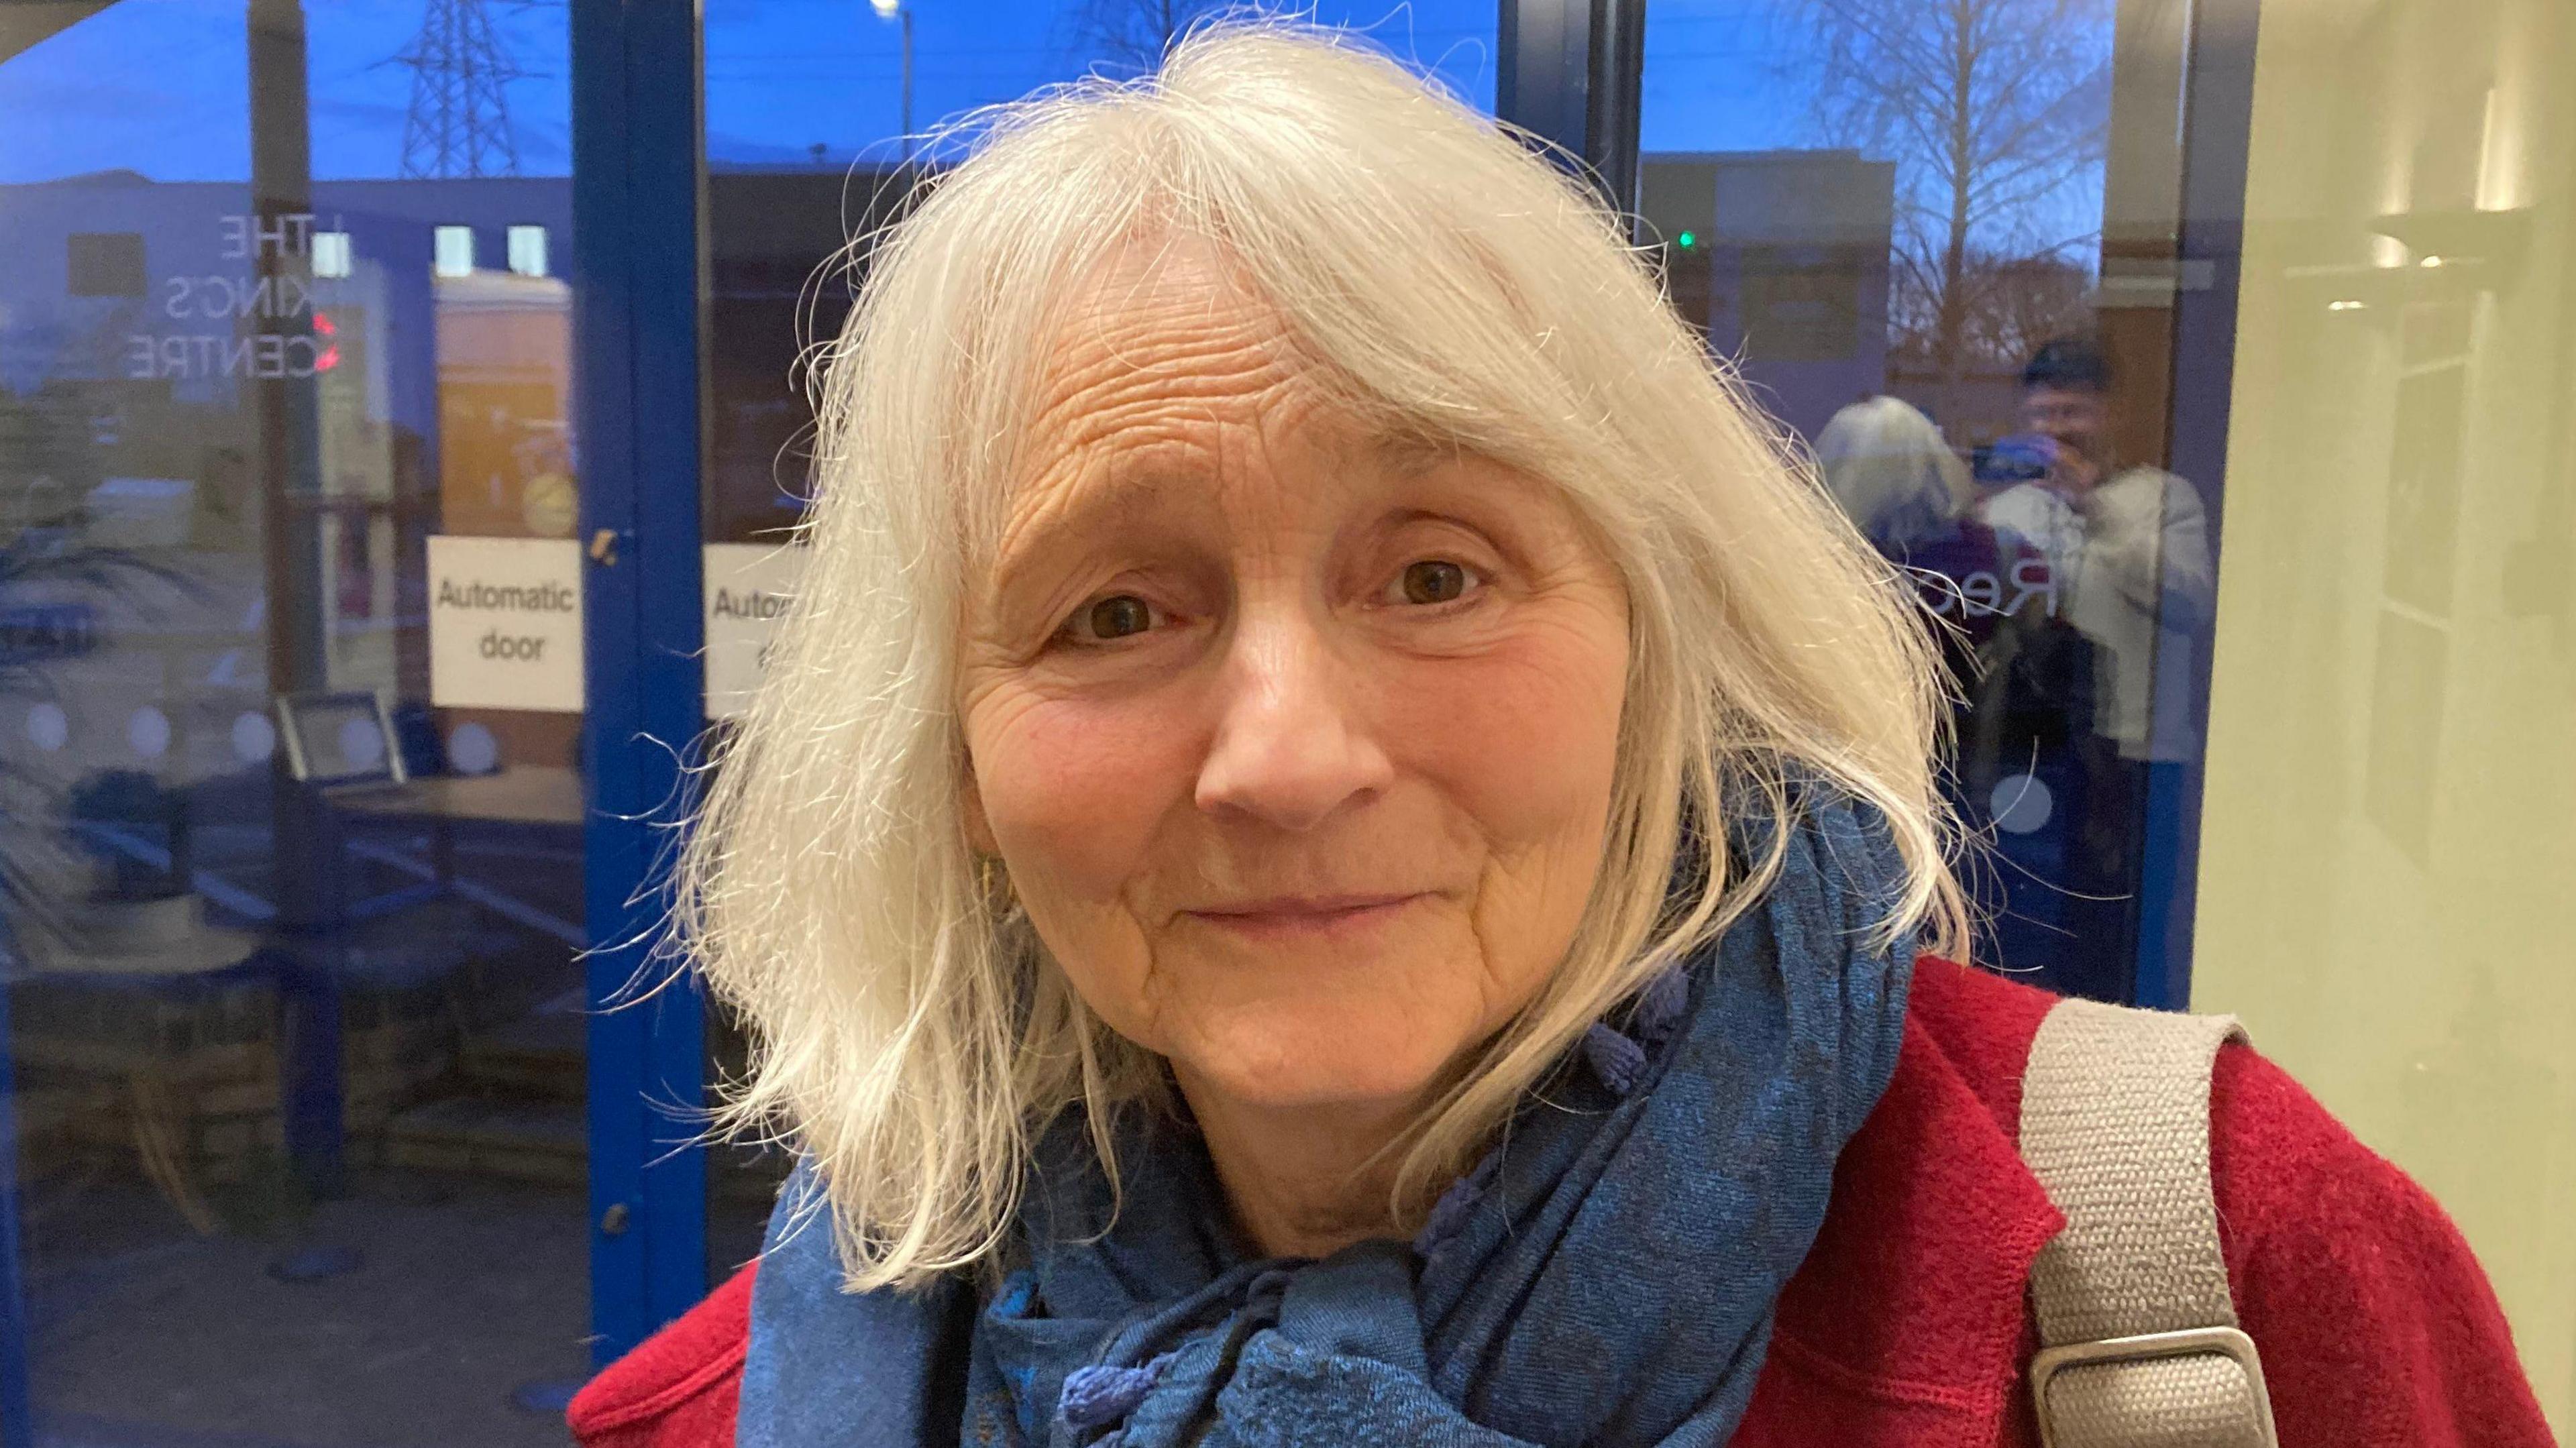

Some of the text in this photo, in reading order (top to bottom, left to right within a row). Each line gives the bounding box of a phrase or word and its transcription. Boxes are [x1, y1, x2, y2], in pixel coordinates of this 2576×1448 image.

[438, 577, 574, 613] Automatic
[712, 587, 792, 619] Auto
[479, 630, 545, 662] door
